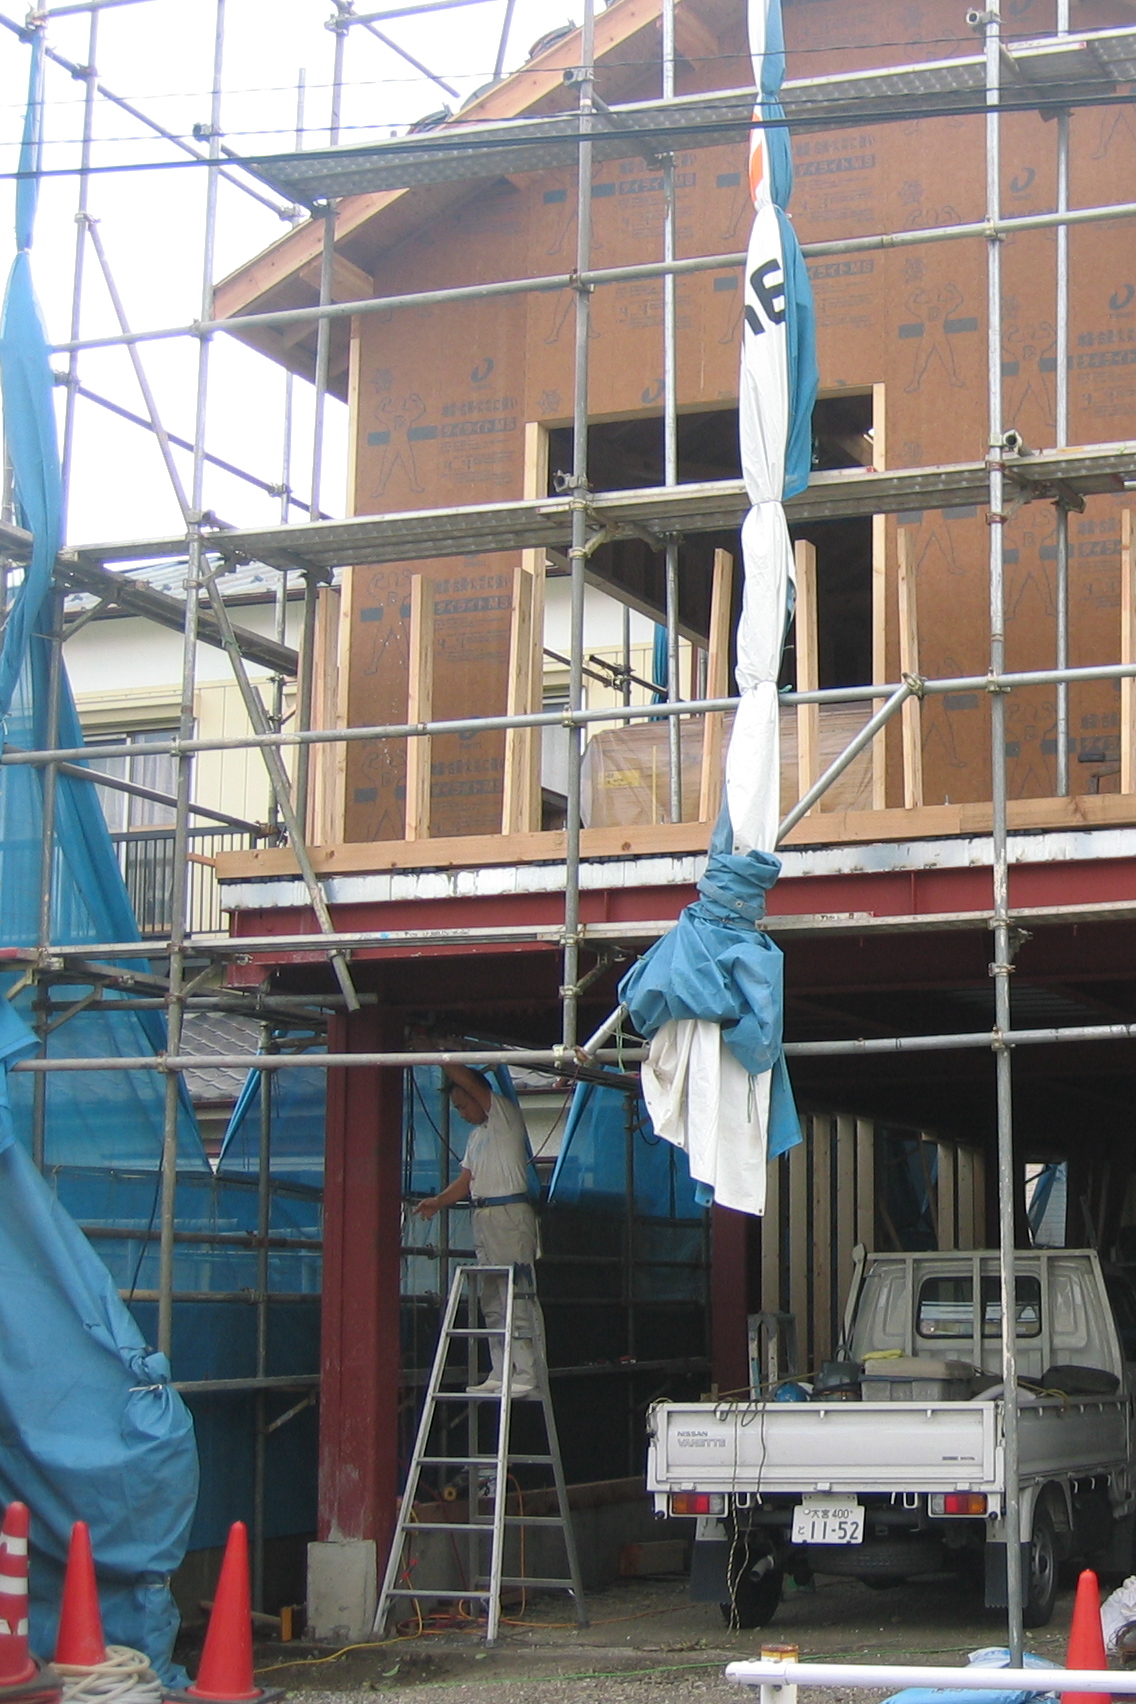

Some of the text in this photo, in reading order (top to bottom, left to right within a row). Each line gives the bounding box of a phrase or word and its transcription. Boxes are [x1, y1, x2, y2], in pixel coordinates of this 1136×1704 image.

[831, 1508, 850, 1519] 400
[797, 1520, 860, 1540] と 11-52
